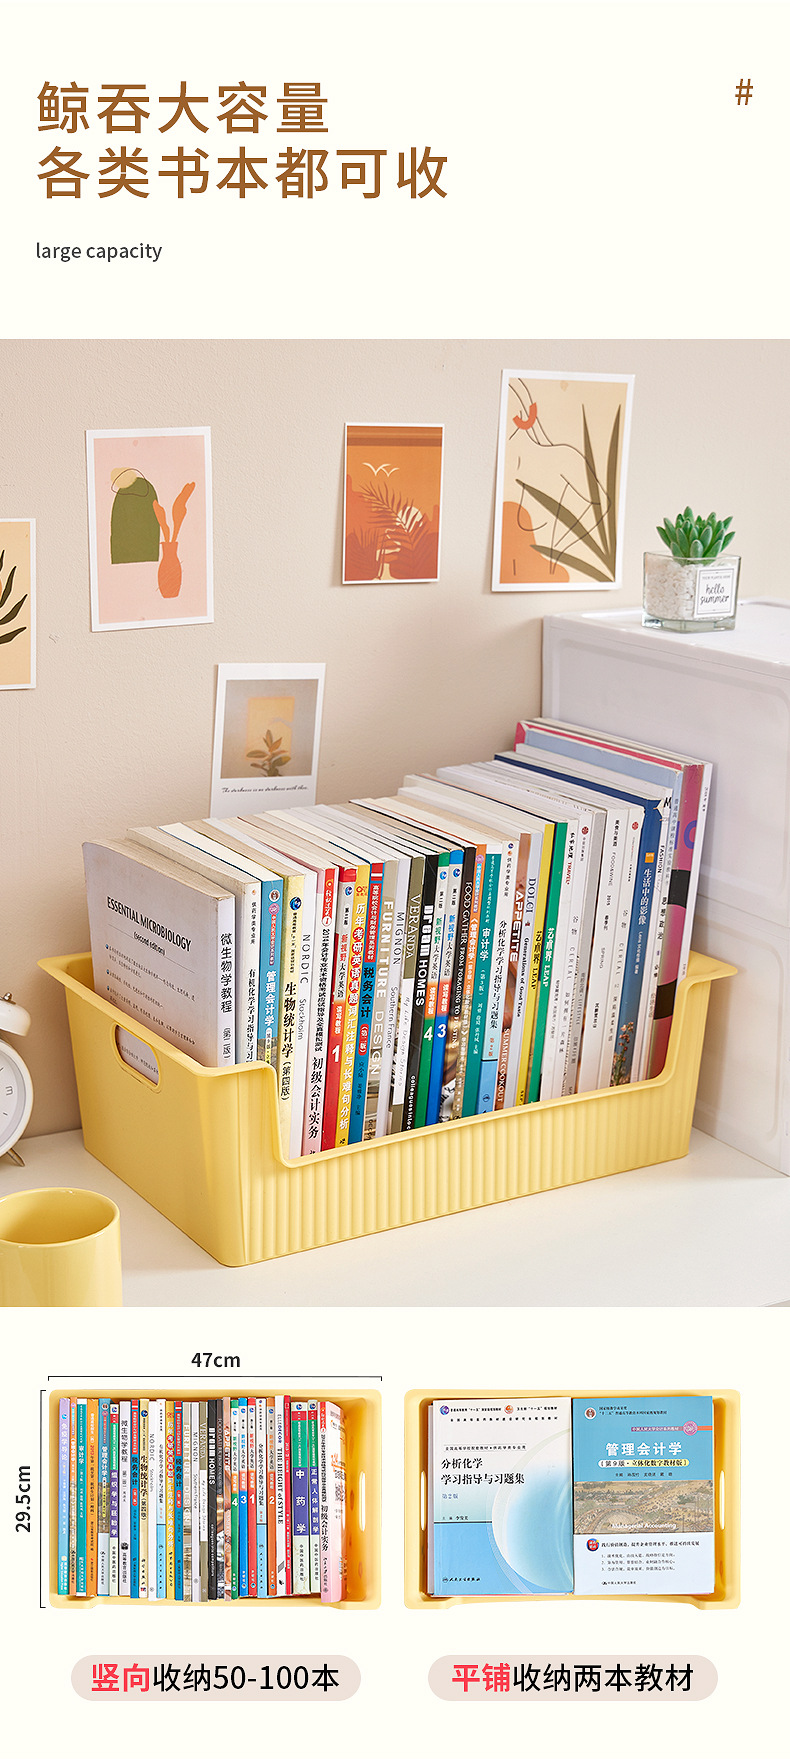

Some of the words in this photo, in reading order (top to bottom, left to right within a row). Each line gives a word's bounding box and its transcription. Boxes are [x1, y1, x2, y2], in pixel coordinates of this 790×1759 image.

[700, 595, 729, 605] summer
[706, 583, 724, 594] hello
[657, 845, 665, 874] FASHION
[463, 881, 473, 909] FOOD
[638, 868, 652, 926] 生活中的影像
[107, 896, 140, 924] ESSENTIAL
[140, 915, 192, 952] MICROBIOLOGY
[393, 911, 405, 965] MIGNON
[405, 893, 422, 959] VERANDA
[510, 890, 524, 962] APPETITE
[300, 934, 311, 984] NORDIC
[376, 901, 394, 999] FURNITURE
[430, 917, 443, 980] 新视野大学英语
[443, 914, 456, 977] 新视野大学英语
[480, 927, 491, 961] 审计学
[520, 937, 530, 977] Generations
[533, 931, 543, 965] 艺术界
[545, 927, 555, 963] 艺术界
[615, 942, 625, 975] CEREAL
[220, 933, 233, 1013] 微生物学教程
[338, 933, 349, 998] 新视野大学英语
[490, 920, 508, 1029] 分析化学学习指导与习题集
[530, 967, 538, 990] LEAP
[542, 964, 551, 987] LEAP
[566, 946, 575, 980] CEREAL
[265, 970, 277, 1026] 管理会计学
[361, 966, 375, 1018] 税务会计
[415, 959, 429, 1007] HOMES
[245, 968, 257, 1065] 有机化学学习指导与习
[281, 981, 297, 1058] 生物统计学
[297, 998, 306, 1041] Stockholm
[389, 986, 399, 1023] Southern
[370, 1010, 384, 1075] DESIGN
[386, 1023, 395, 1049] France
[423, 1026, 433, 1041] 4
[436, 1023, 447, 1038] 3
[331, 1044, 340, 1062] 1
[5, 1086, 14, 1096] 3
[308, 1057, 324, 1140] 初级会计实务
[441, 1458, 483, 1469] 分析化学
[605, 1441, 682, 1457] 管理会计学
[441, 1473, 525, 1485] 学习指导与习题集
[231, 1497, 238, 1507] 4
[240, 1495, 247, 1504] 3
[249, 1494, 255, 1504] 1
[269, 1496, 275, 1505] 2
[295, 1469, 306, 1534] 中药学
[310, 1468, 319, 1533] 正常人体解剖学
